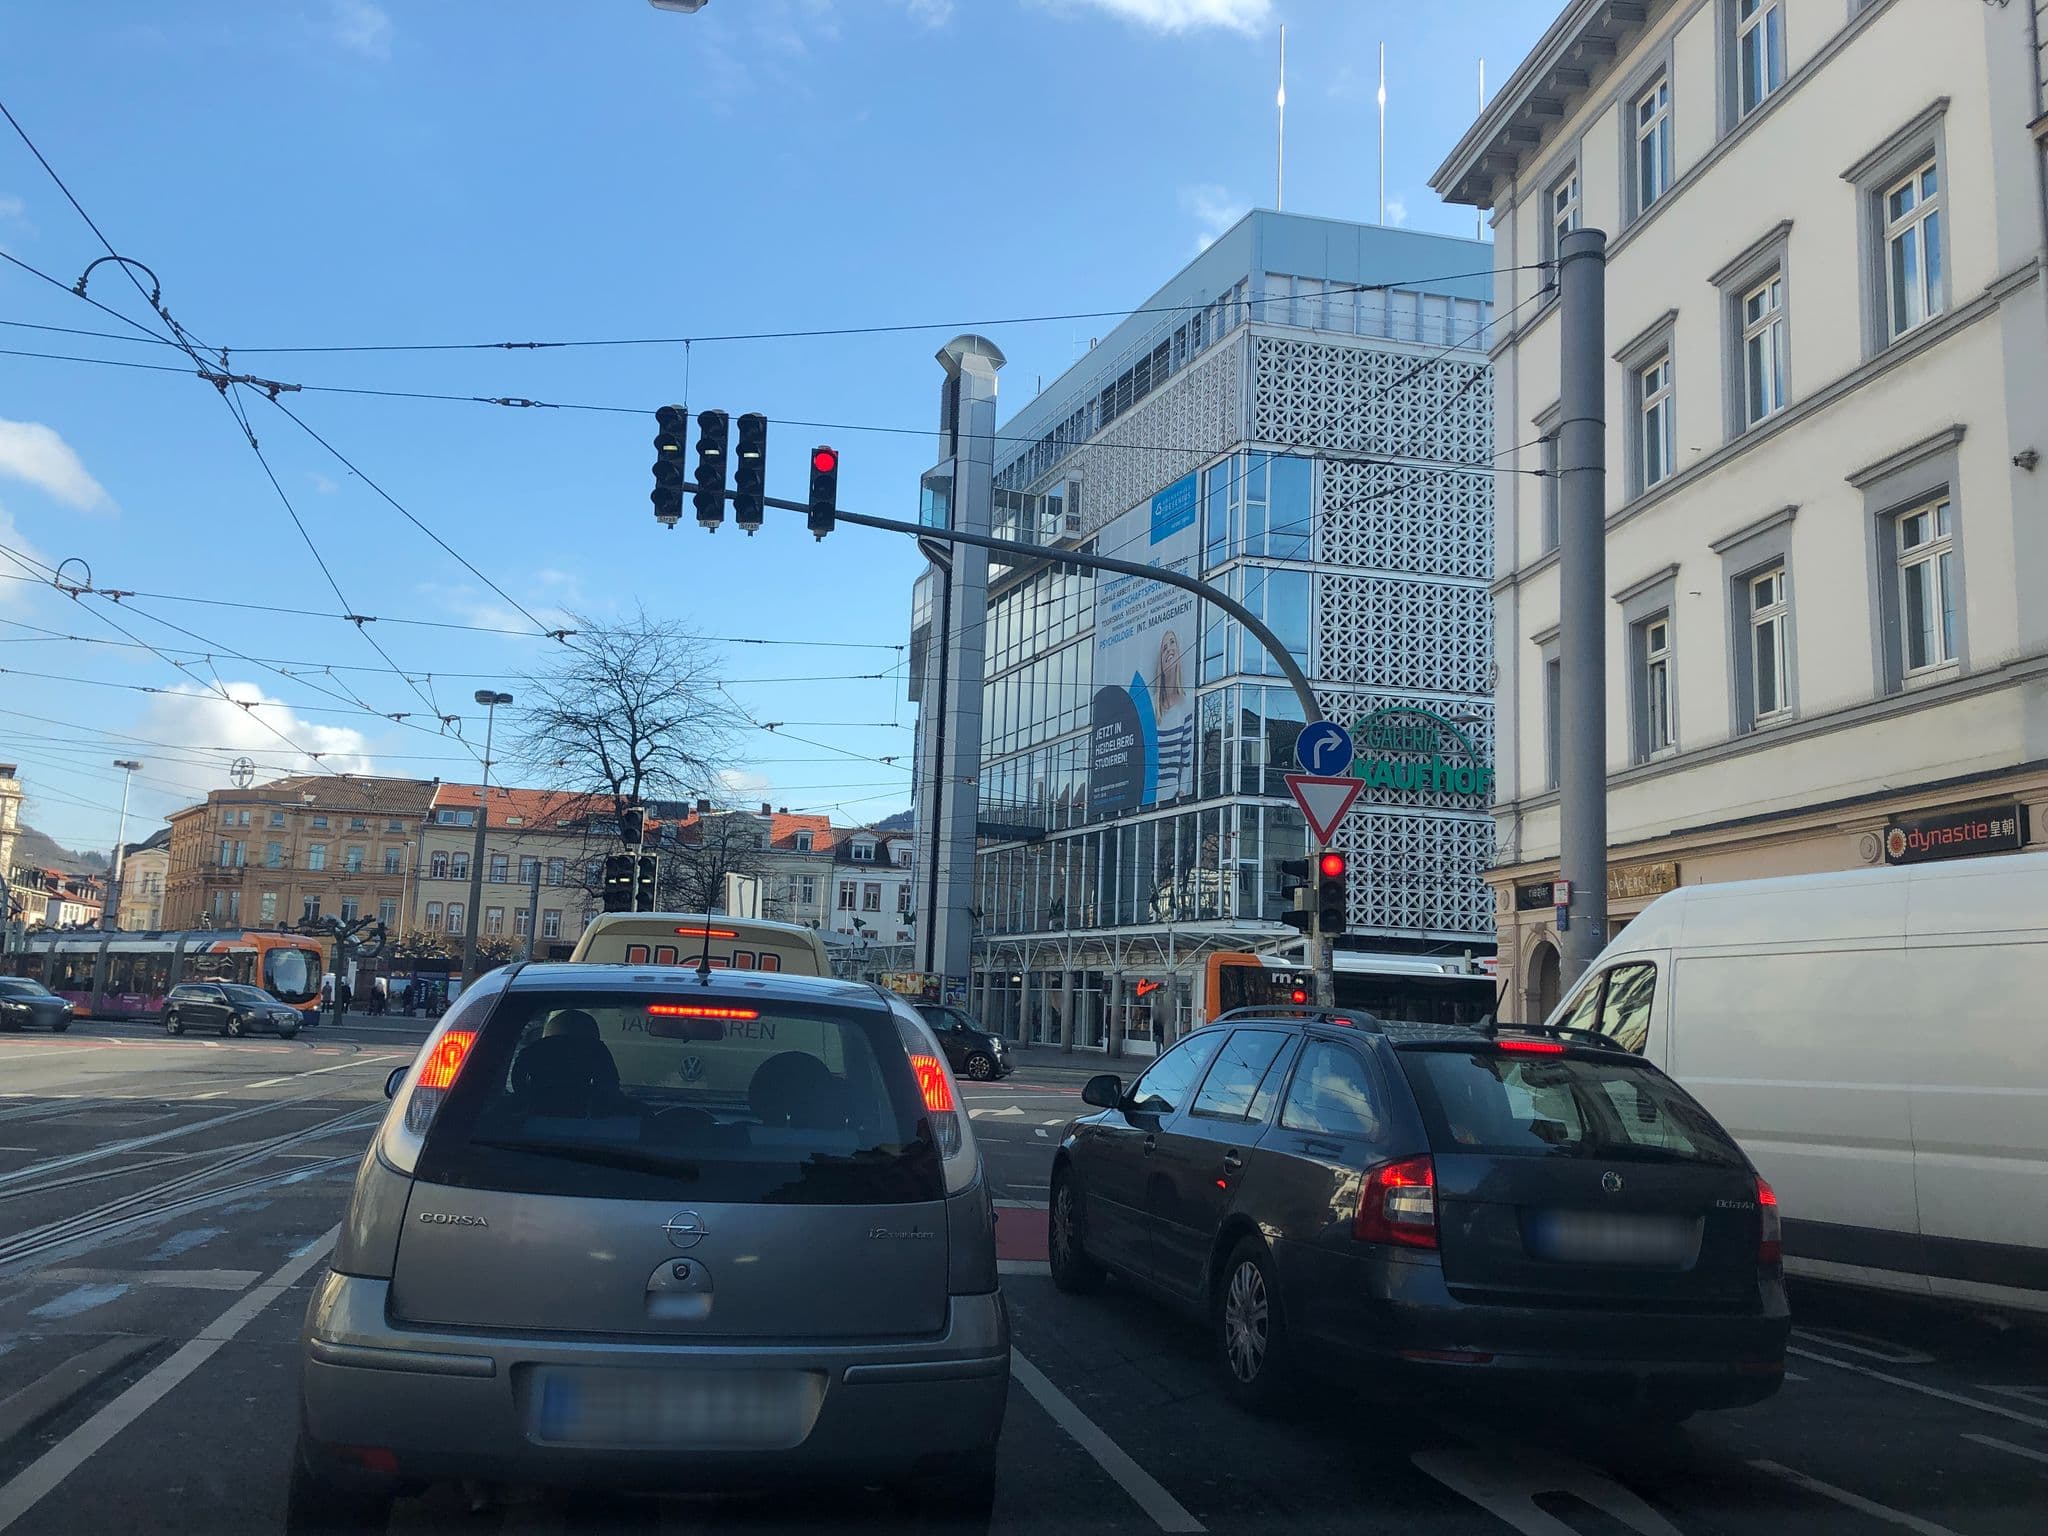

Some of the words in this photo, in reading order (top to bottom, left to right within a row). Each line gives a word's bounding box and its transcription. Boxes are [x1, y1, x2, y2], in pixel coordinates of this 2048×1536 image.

[1149, 600, 1193, 629] MANAGEMENT
[1096, 723, 1114, 741] JETZT
[1114, 721, 1122, 735] IN
[1367, 724, 1441, 751] GALERIA
[1095, 733, 1134, 756] HEIDELBERG
[1095, 751, 1128, 770] STUDIEREN!
[1908, 820, 1988, 852] dynastie
[1990, 817, 2015, 838] 皇朝
[1272, 972, 1292, 985] rn
[420, 1212, 488, 1227] CORSA
